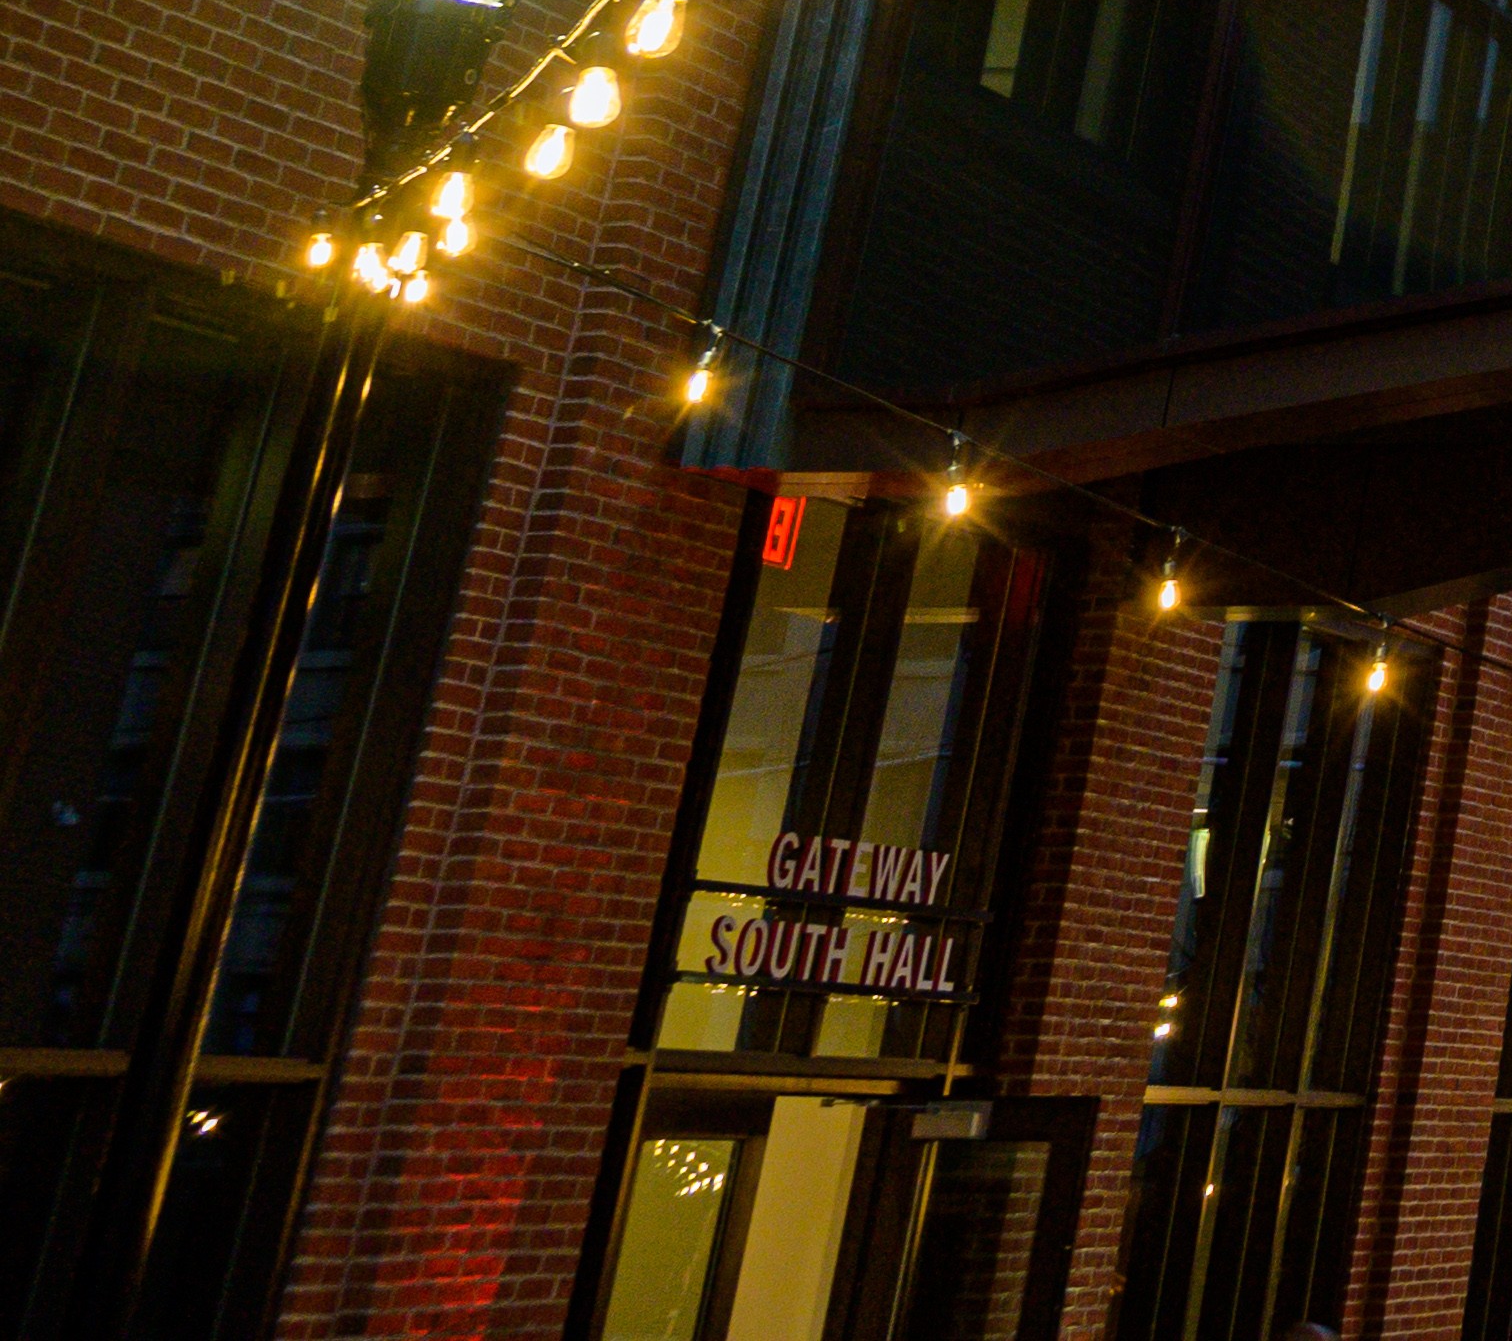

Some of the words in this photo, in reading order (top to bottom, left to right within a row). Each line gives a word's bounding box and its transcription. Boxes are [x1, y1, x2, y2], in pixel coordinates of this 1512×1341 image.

[769, 831, 950, 906] GATEWAY
[706, 914, 852, 984] SOUTH
[862, 929, 955, 992] HALL
